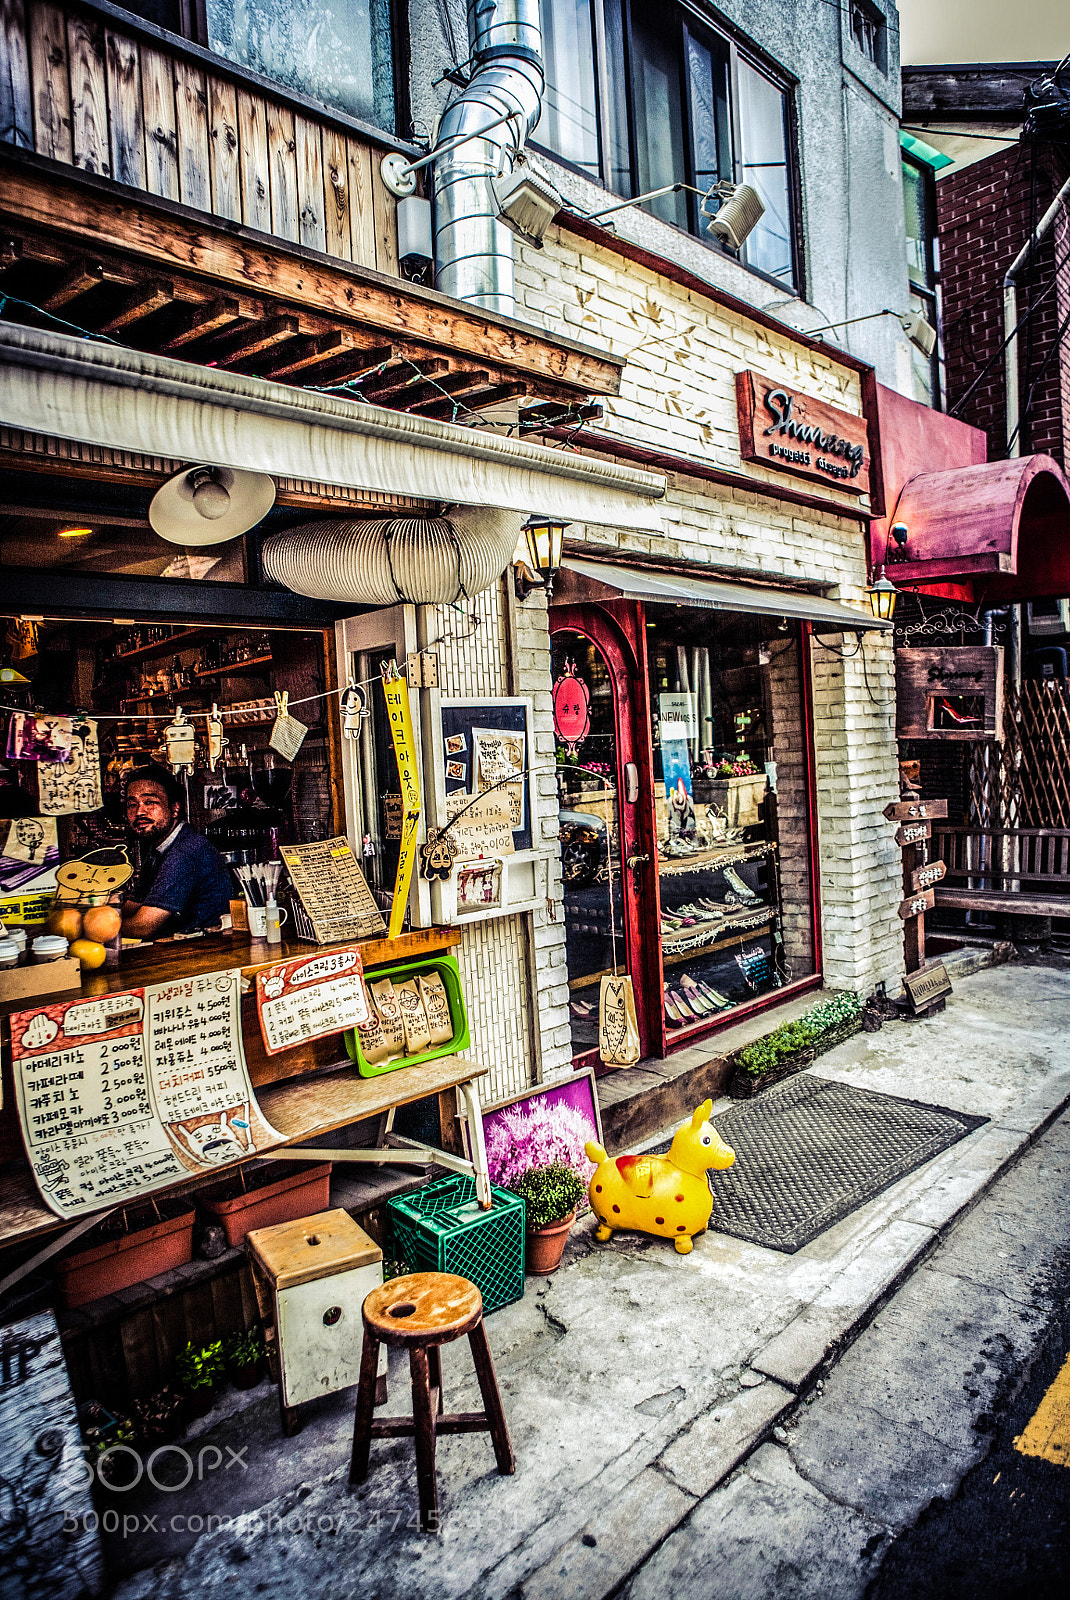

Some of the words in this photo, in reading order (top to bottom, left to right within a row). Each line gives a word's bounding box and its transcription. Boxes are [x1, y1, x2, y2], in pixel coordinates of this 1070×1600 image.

[489, 836, 511, 850] 2010
[156, 980, 194, 1003] 생과일
[196, 978, 214, 993] 쥬스
[153, 1005, 193, 1023] 키위쥬스
[26, 1049, 85, 1073] 아메리카노
[155, 1049, 195, 1067] 자몽쥬스
[27, 1070, 85, 1092] 카페라떼
[158, 1069, 205, 1091] 더치커피
[30, 1087, 80, 1110] 카푸치노
[163, 1085, 203, 1108] 핸드드립
[204, 1080, 229, 1095] 커피
[32, 1104, 84, 1125] 카페모카
[168, 1107, 183, 1122] 모두
